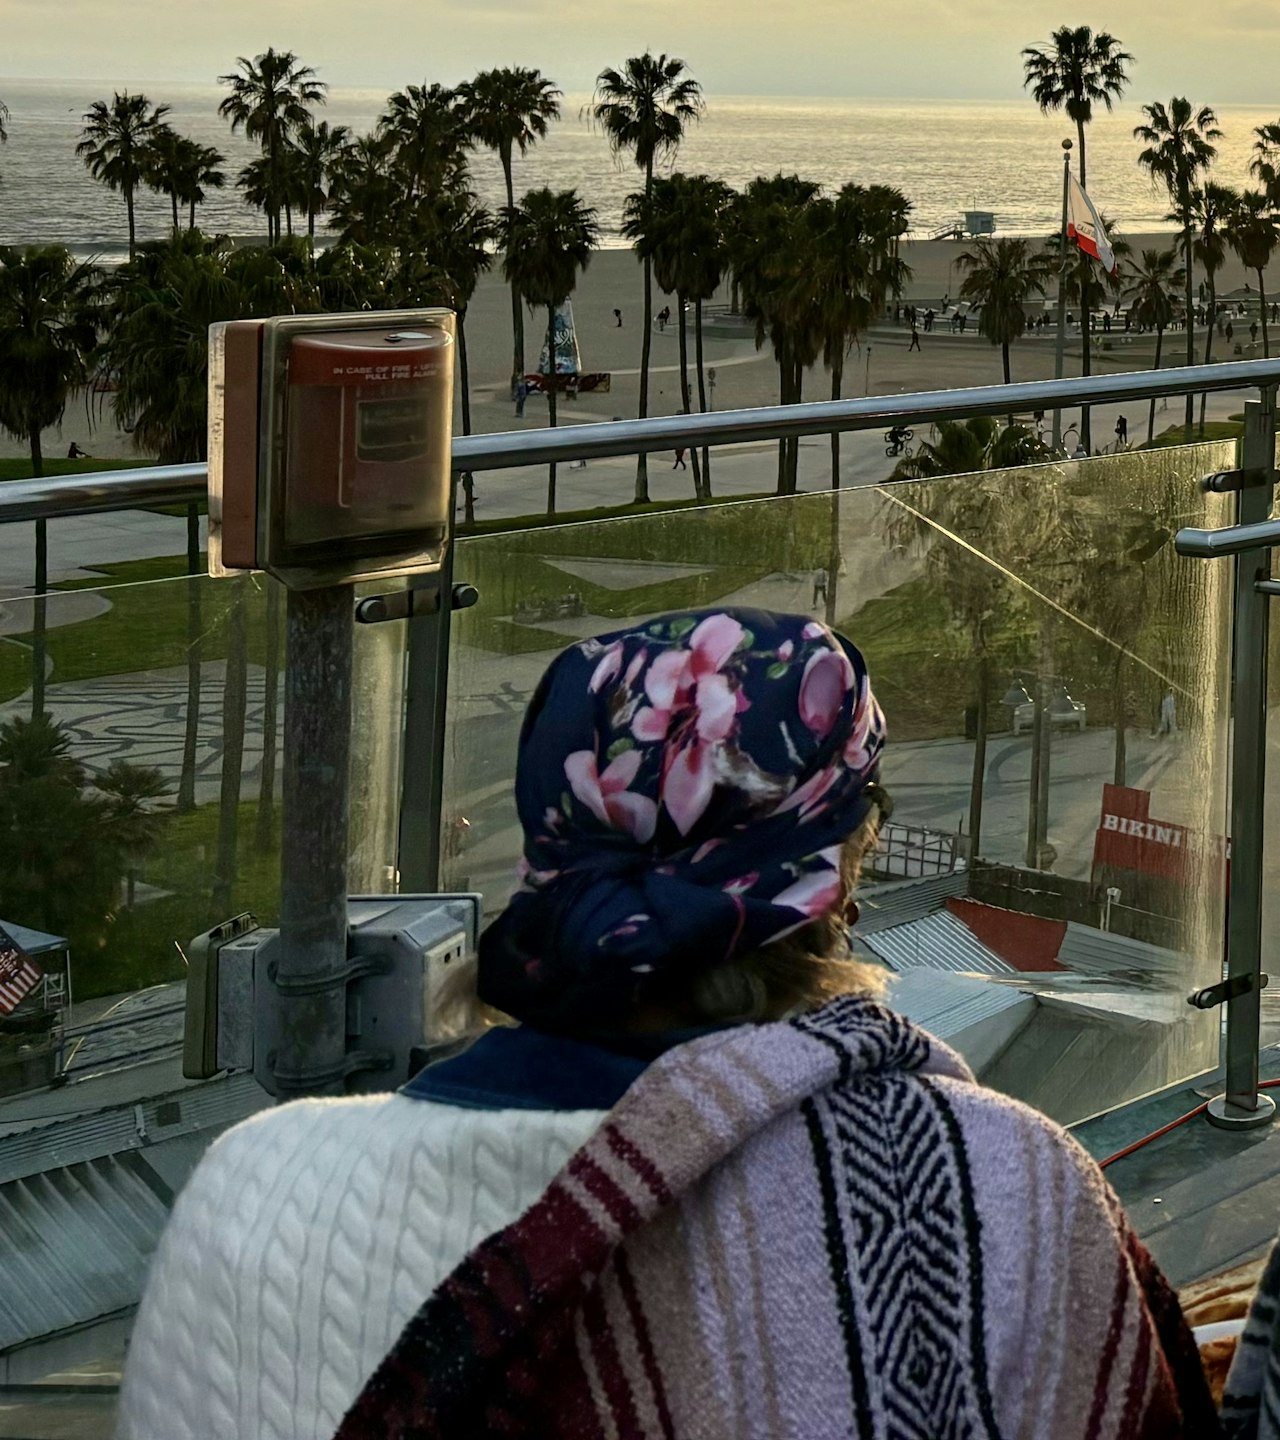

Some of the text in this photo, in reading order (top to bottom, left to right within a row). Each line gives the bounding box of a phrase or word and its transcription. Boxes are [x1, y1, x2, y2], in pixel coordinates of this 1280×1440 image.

[346, 366, 372, 374] CASE
[365, 372, 389, 380] PULL
[1103, 814, 1182, 847] BIKINI
